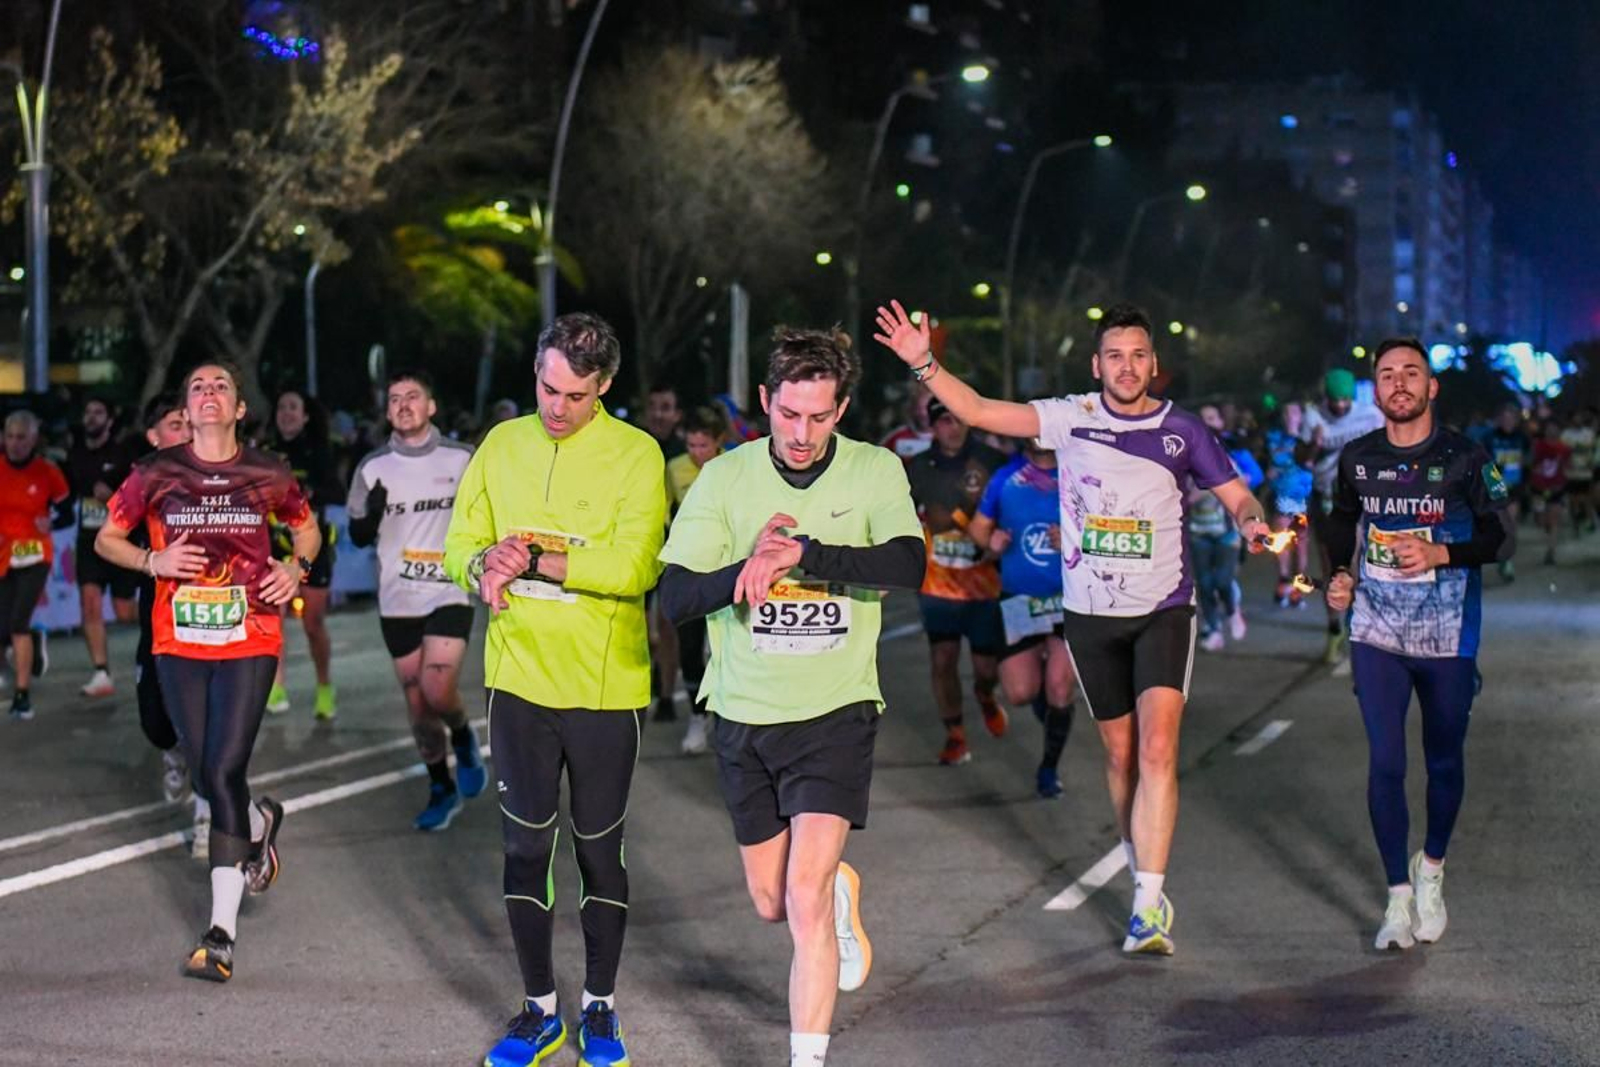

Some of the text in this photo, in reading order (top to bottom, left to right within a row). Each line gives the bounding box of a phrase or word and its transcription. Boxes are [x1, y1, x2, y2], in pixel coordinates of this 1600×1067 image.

[201, 495, 232, 506] XXIX
[1359, 494, 1445, 515] AN ANTÓN
[1086, 530, 1148, 553] 1463
[180, 602, 242, 625] 1514
[758, 602, 842, 627] 9529
